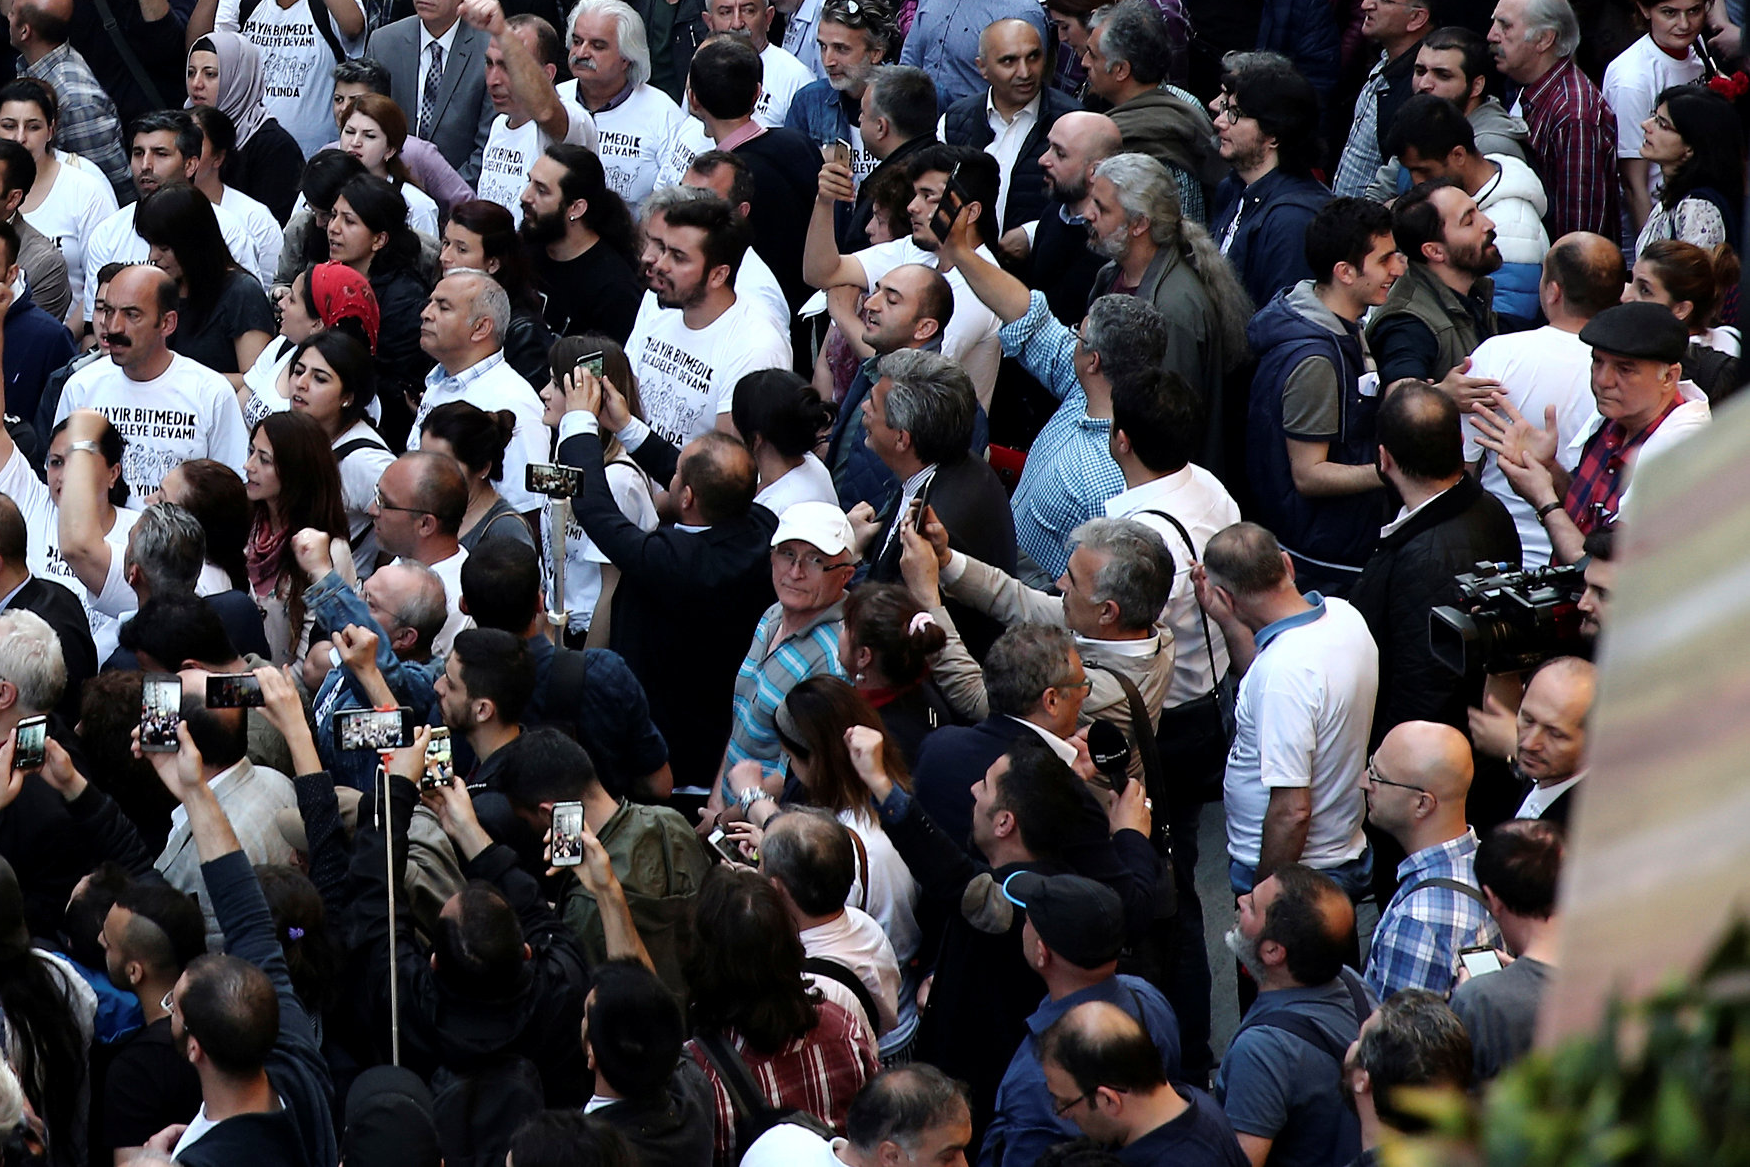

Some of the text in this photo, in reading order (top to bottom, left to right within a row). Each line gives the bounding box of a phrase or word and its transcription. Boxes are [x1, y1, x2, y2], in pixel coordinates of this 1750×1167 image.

[243, 21, 272, 35] HAYIR
[265, 86, 300, 98] YILINDA
[602, 145, 640, 158] DEVAM!
[152, 426, 195, 440] DEVAM!
